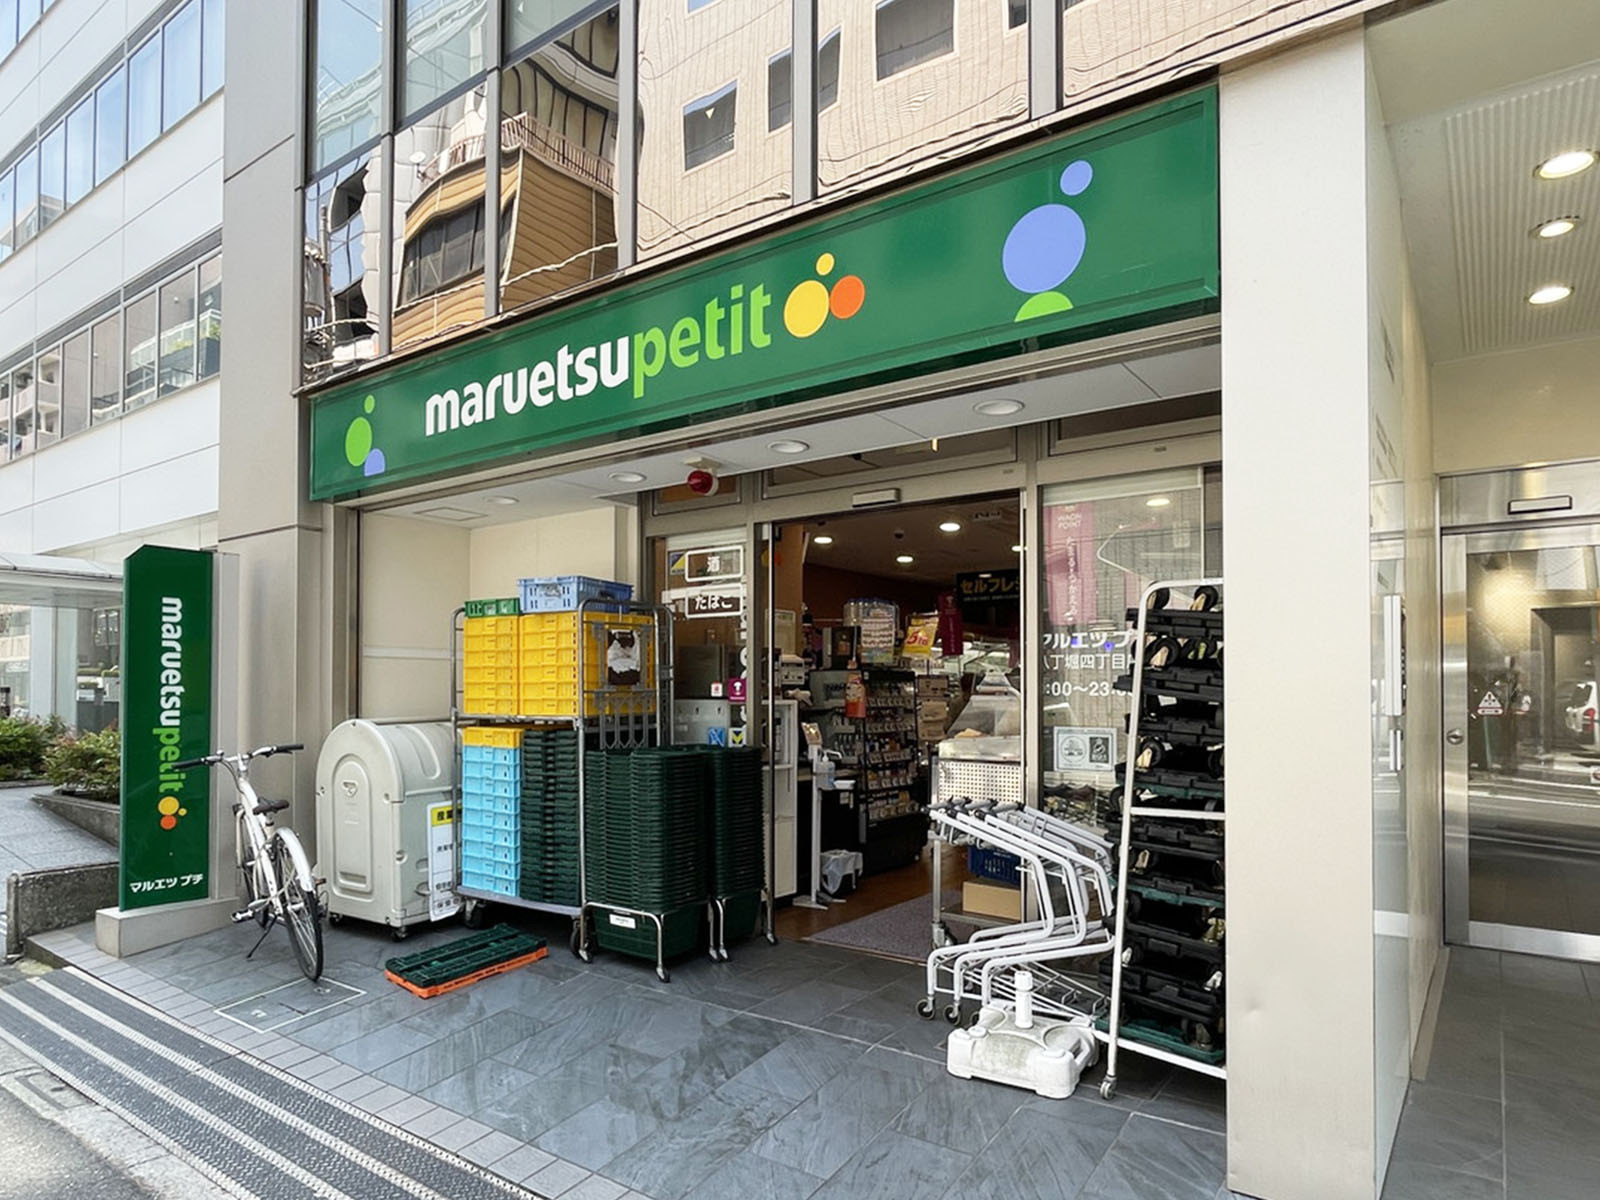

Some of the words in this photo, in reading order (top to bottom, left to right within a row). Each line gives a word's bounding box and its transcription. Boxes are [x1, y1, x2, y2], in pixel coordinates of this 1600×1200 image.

[707, 556, 720, 572] 酒
[695, 594, 732, 610] たばこ
[129, 877, 178, 893] マルエツ
[180, 873, 203, 887] プチ
